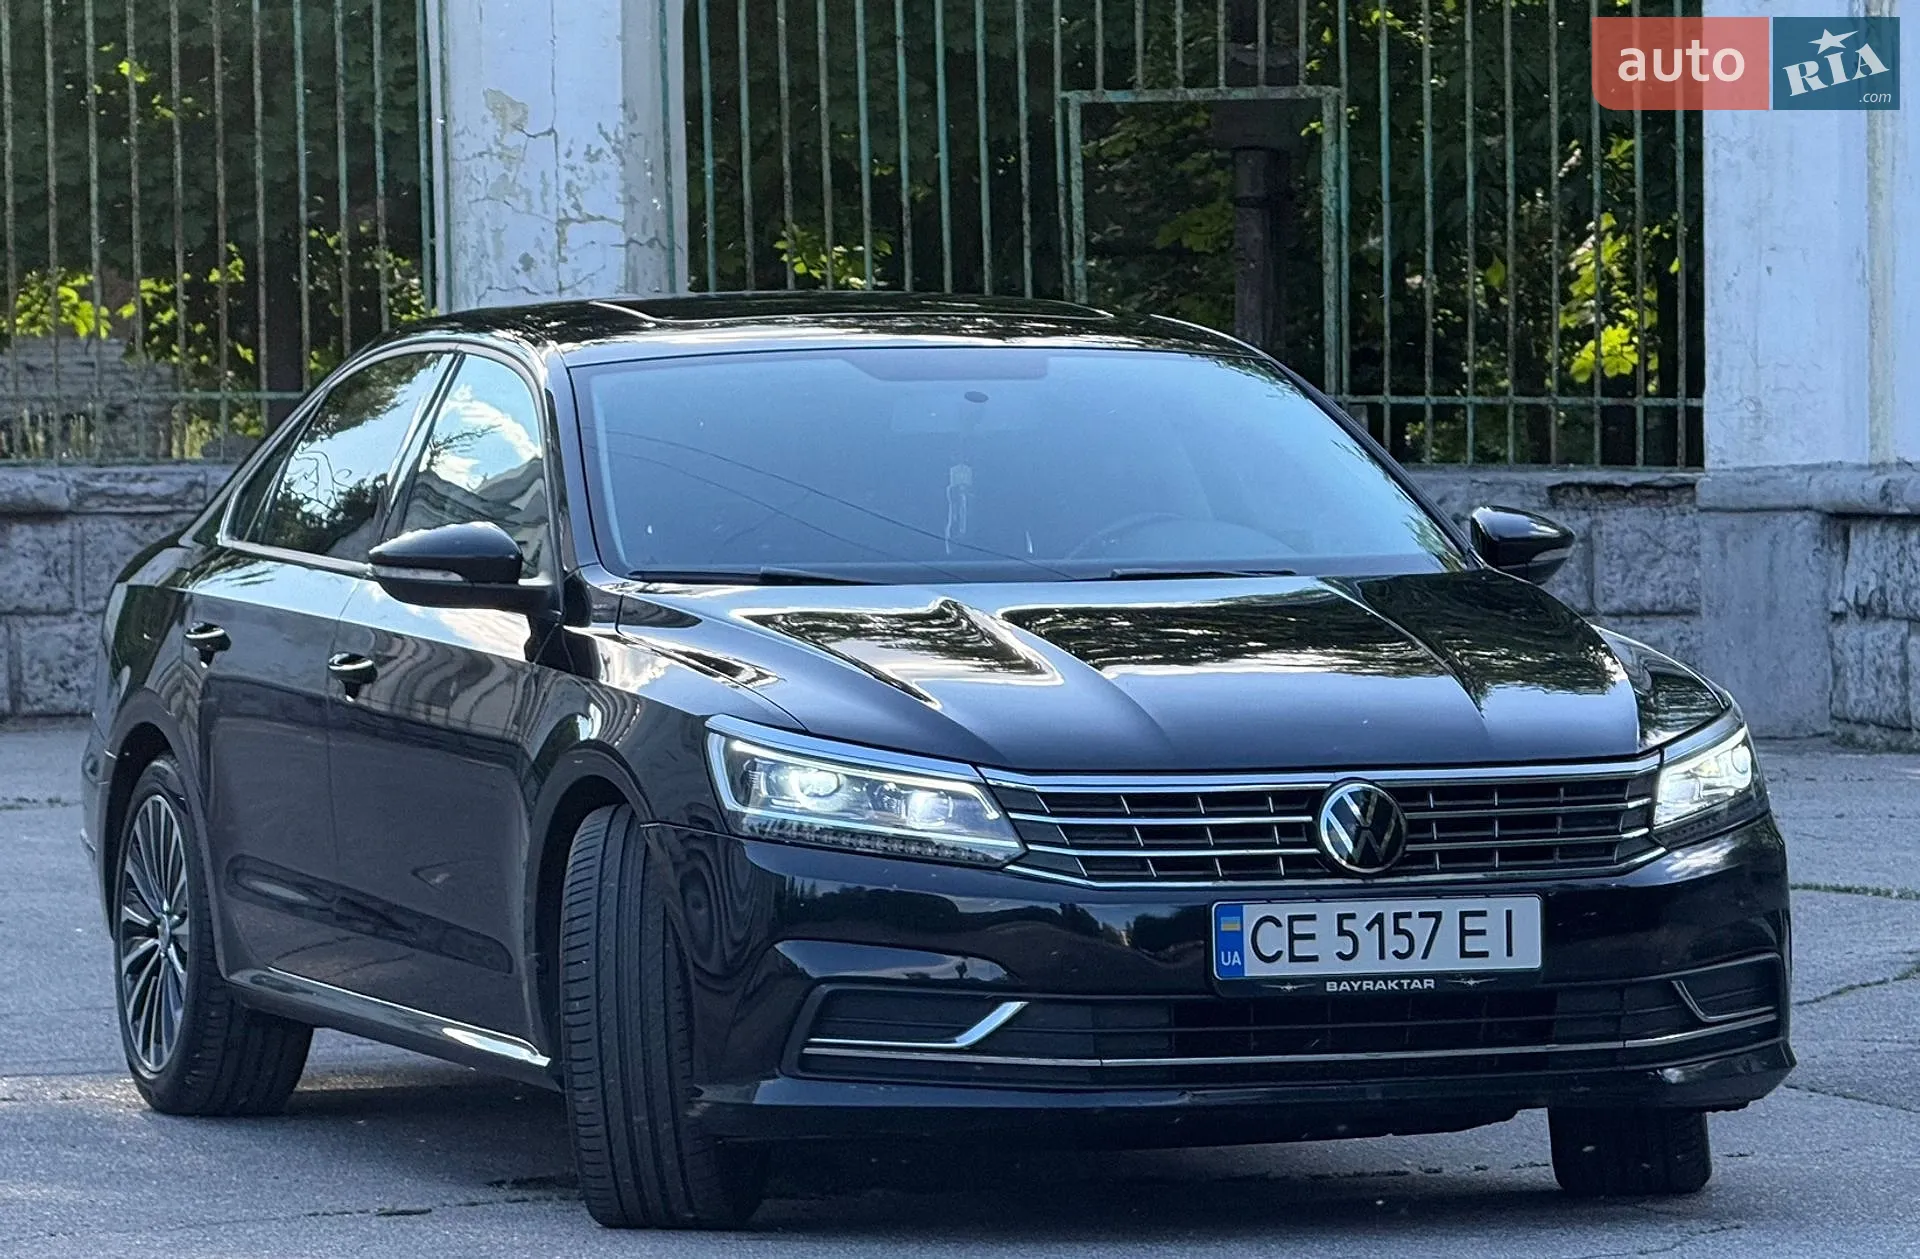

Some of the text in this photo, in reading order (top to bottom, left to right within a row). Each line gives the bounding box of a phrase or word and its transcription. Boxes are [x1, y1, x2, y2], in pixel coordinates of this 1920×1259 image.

[1250, 909, 1513, 963] CE 5157 EI
[1221, 951, 1242, 966] UA
[1325, 978, 1435, 992] BAYRAKTAR
